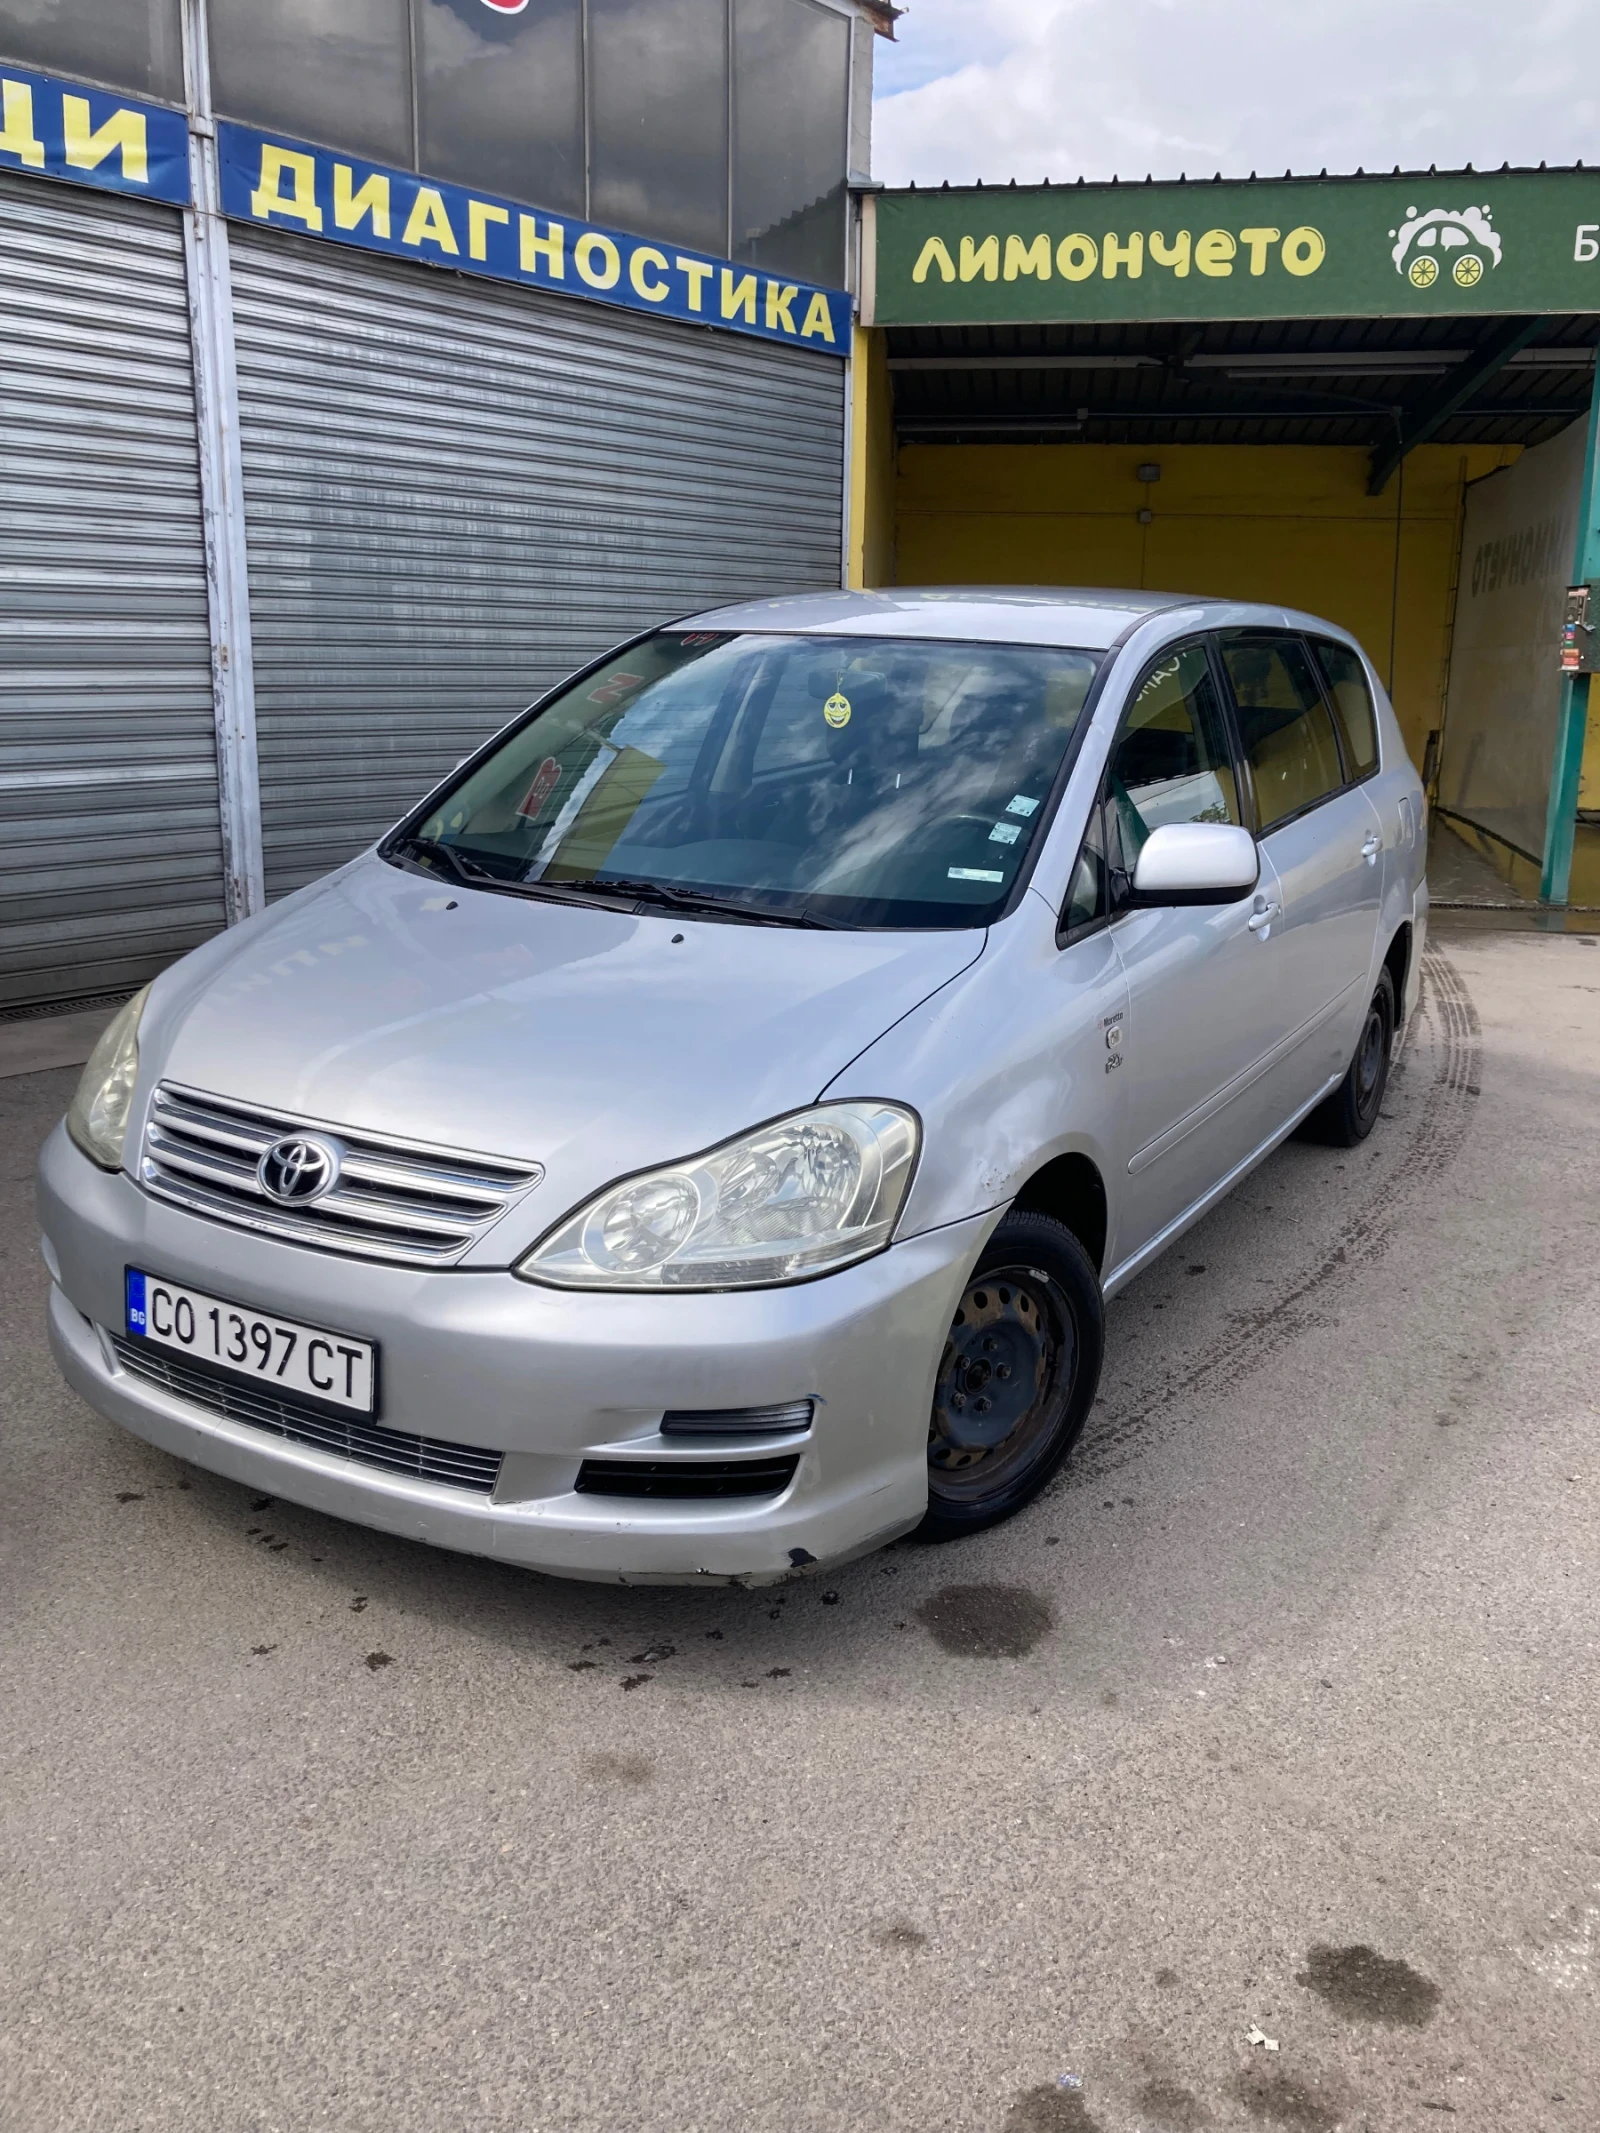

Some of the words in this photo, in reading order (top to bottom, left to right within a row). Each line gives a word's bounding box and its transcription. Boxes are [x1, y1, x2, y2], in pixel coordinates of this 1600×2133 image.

[251, 143, 836, 344] ДИАГНОСТИКА
[130, 1308, 146, 1325] BG
[152, 1287, 195, 1344] CO
[208, 1307, 297, 1377] 1397
[308, 1338, 363, 1398] CT
